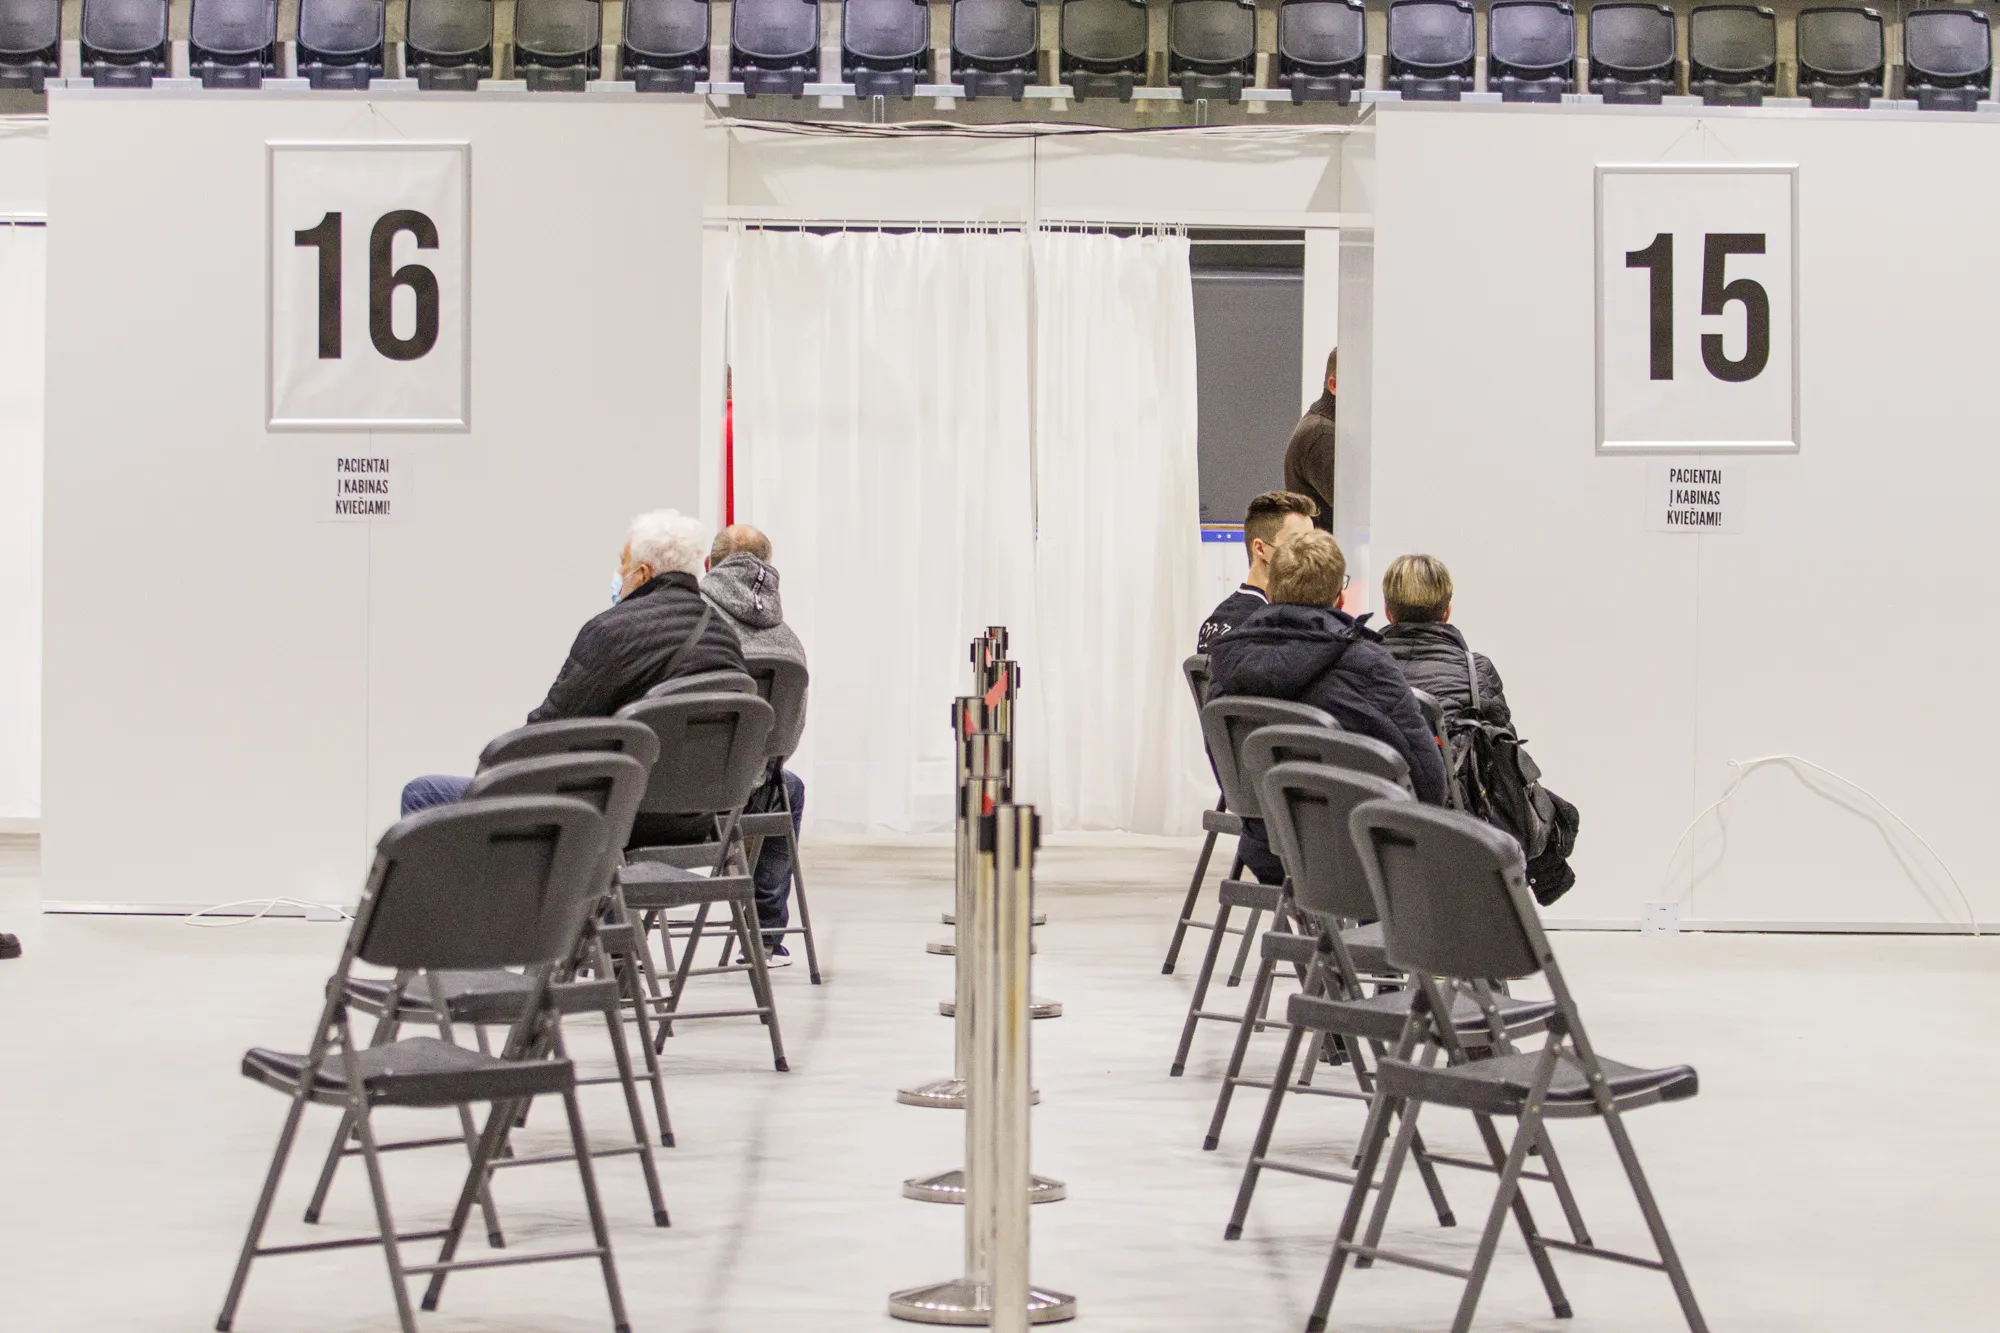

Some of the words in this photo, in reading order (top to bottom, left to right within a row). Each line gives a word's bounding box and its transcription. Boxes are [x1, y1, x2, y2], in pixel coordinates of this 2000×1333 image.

[294, 209, 439, 361] 16
[1625, 233, 1770, 383] 15
[337, 458, 389, 473] PACIENTAI
[1669, 468, 1722, 485] PACIENTAI
[344, 479, 389, 494] KABINAS
[335, 496, 391, 515] KVIEČIAMI!
[1676, 489, 1721, 505] KABINAS
[1667, 507, 1722, 527] KVIEČIAMI!
